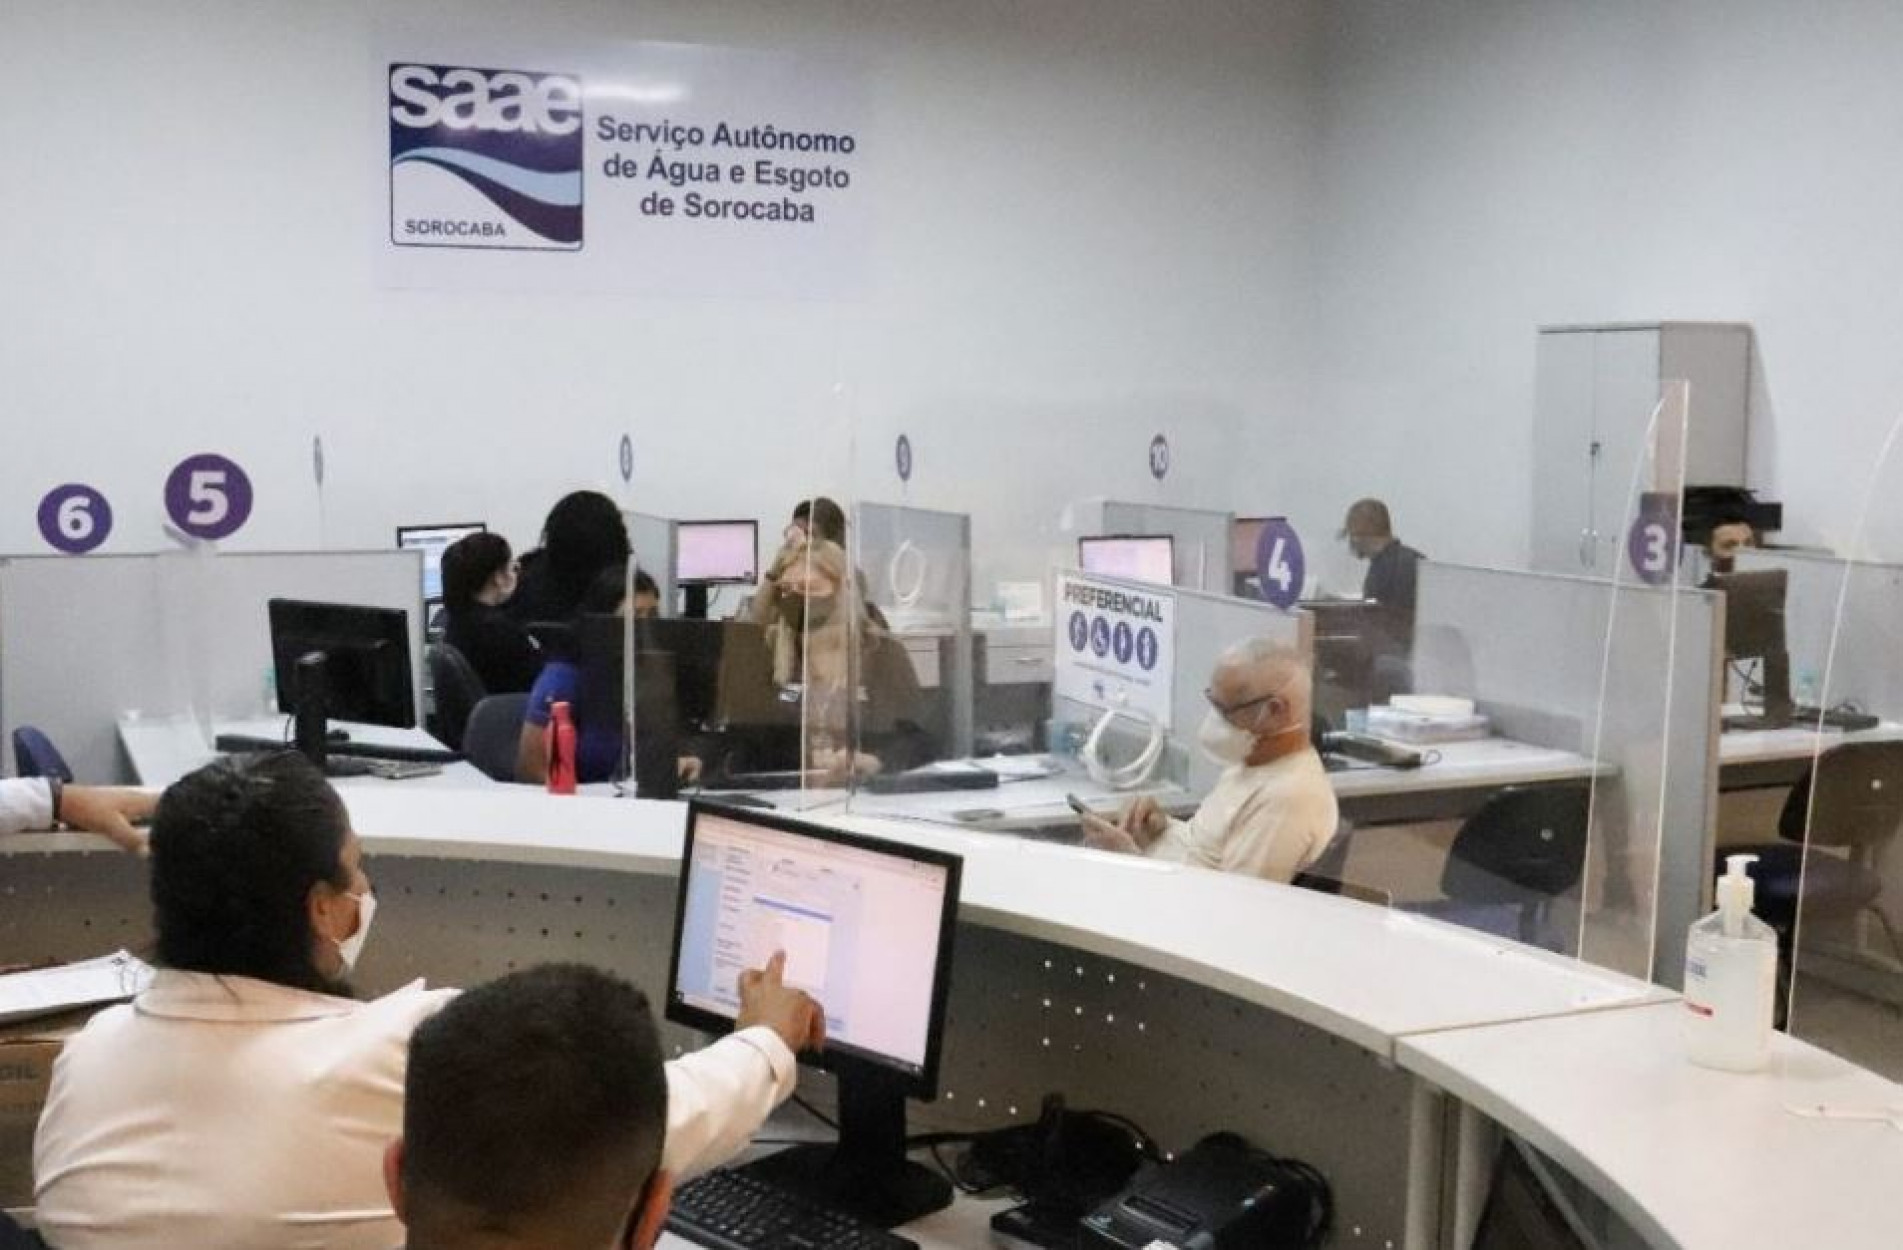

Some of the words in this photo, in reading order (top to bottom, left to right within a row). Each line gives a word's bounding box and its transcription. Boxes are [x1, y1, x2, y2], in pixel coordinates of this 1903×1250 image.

[391, 67, 581, 135] saae
[597, 115, 704, 149] Serviço
[712, 122, 856, 153] Autônomo
[603, 153, 637, 178] de
[647, 149, 720, 186] Água
[731, 164, 745, 183] e
[755, 160, 849, 192] Esgoto
[405, 219, 506, 237] SOROCABA
[640, 191, 674, 216] de
[684, 192, 815, 222] Sorocaba
[58, 496, 94, 540] 6
[188, 470, 229, 525] 5
[1268, 537, 1292, 591] 4
[1643, 523, 1667, 571] 3
[1064, 582, 1164, 622] PREFERENCIAL
